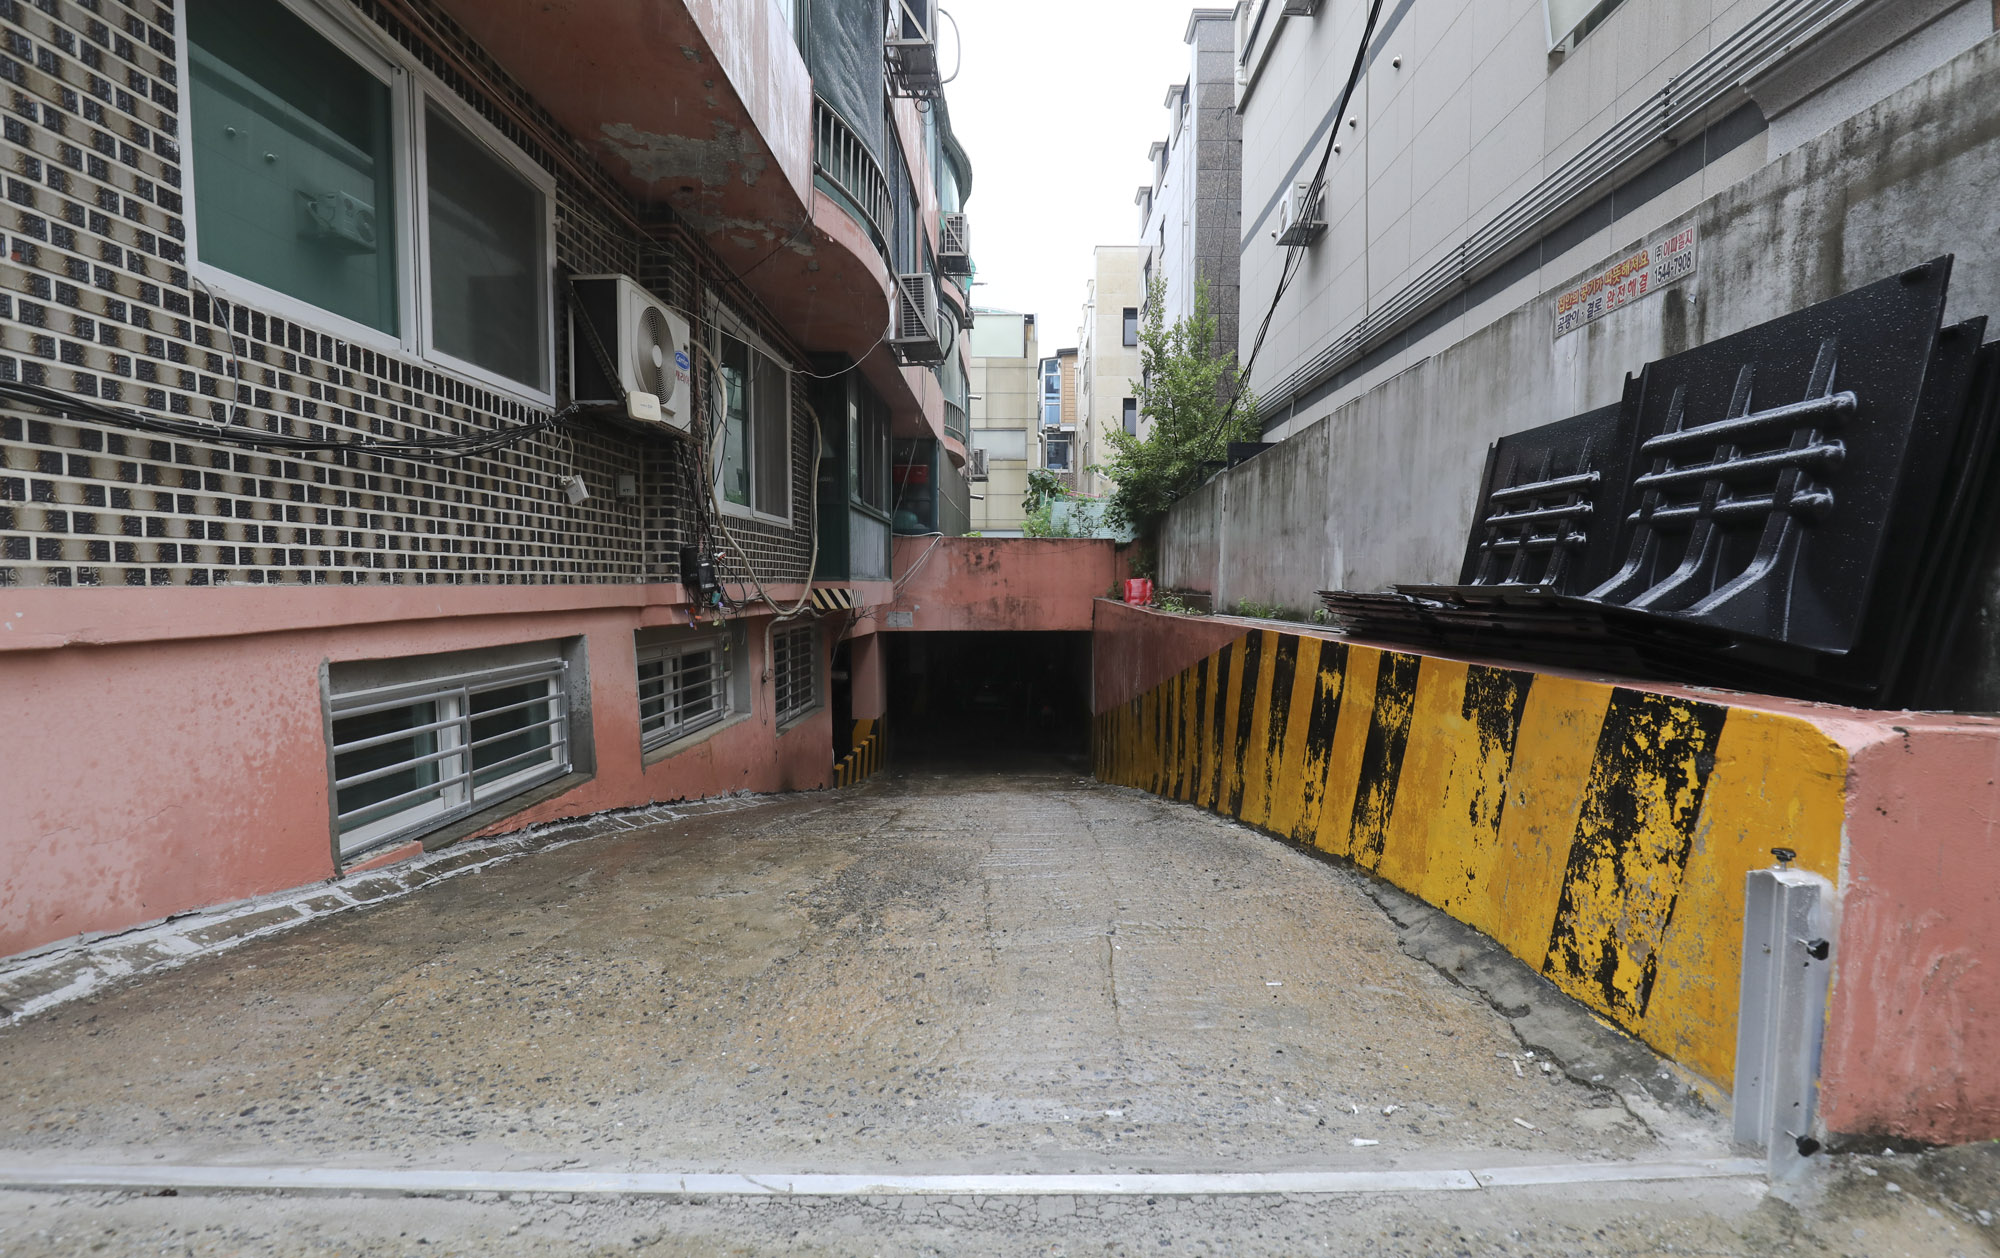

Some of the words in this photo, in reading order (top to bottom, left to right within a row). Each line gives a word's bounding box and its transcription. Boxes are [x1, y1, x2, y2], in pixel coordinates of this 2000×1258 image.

[1654, 250, 1692, 284] 1544-7908
[1557, 289, 1579, 315] 집안의
[1580, 275, 1604, 303] 공기가
